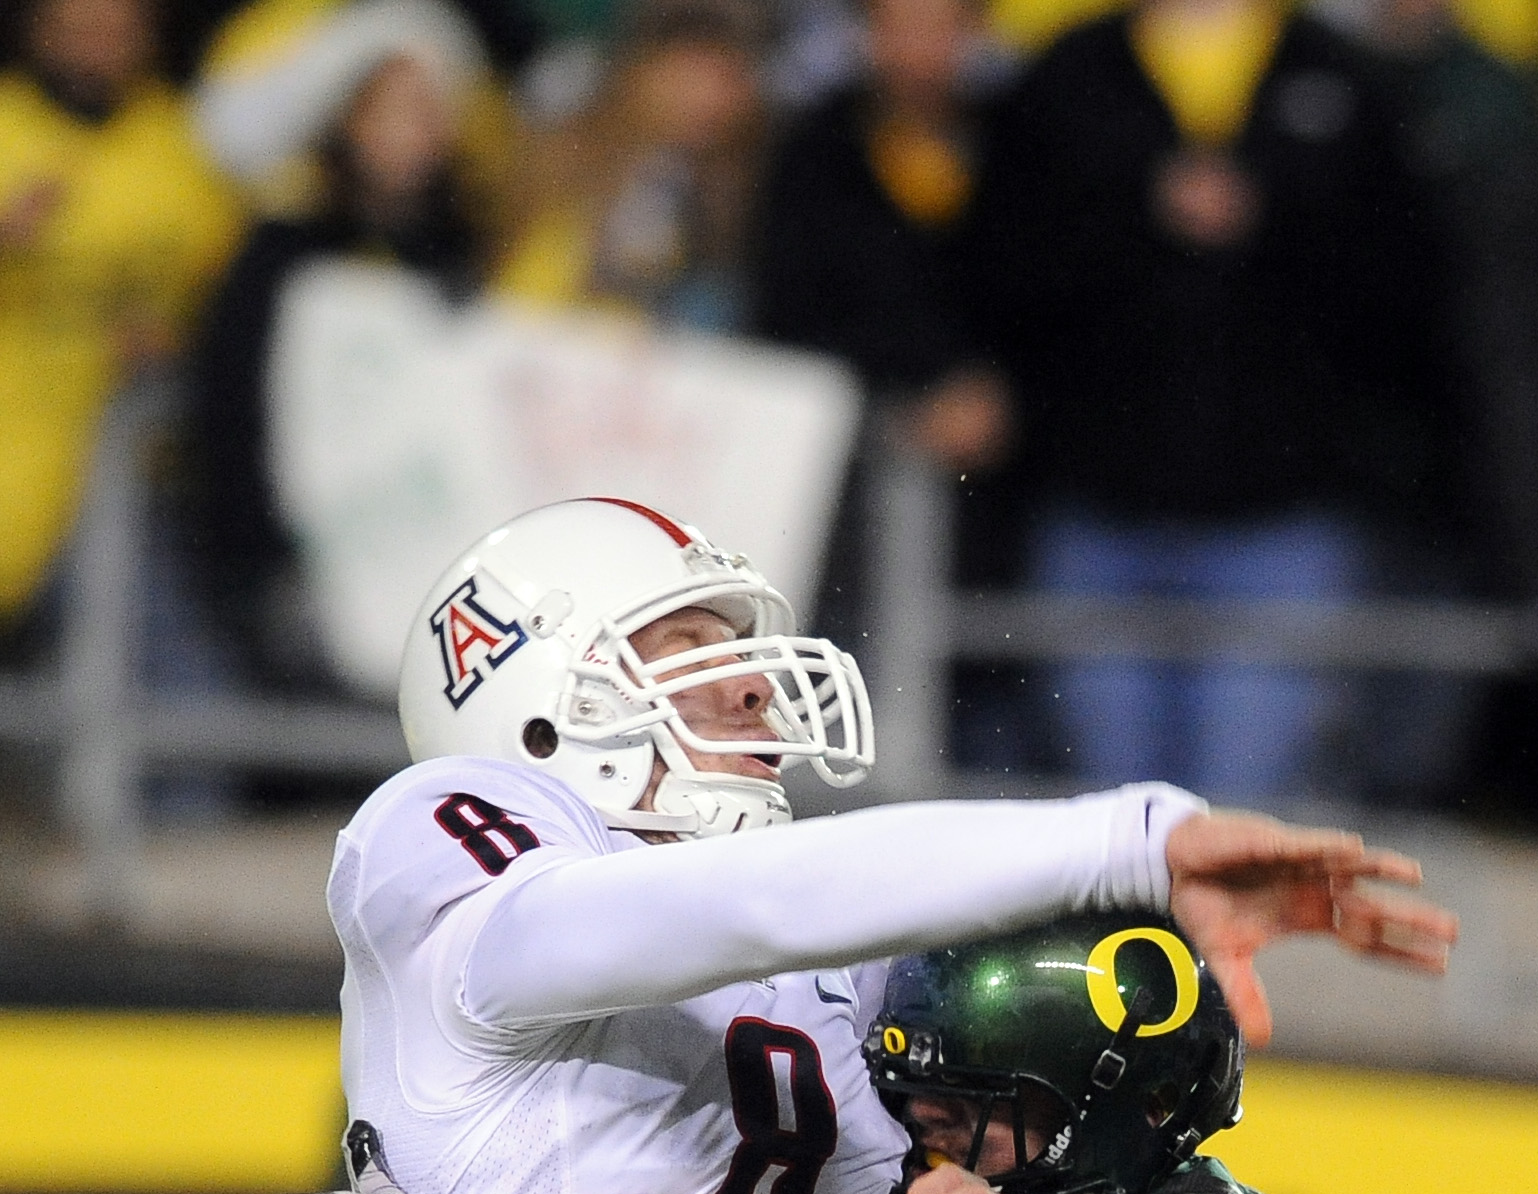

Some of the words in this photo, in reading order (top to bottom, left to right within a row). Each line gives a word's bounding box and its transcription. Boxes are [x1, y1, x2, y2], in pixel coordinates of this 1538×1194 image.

[430, 575, 529, 711] A
[433, 792, 541, 877] 8
[1086, 927, 1199, 1037] O
